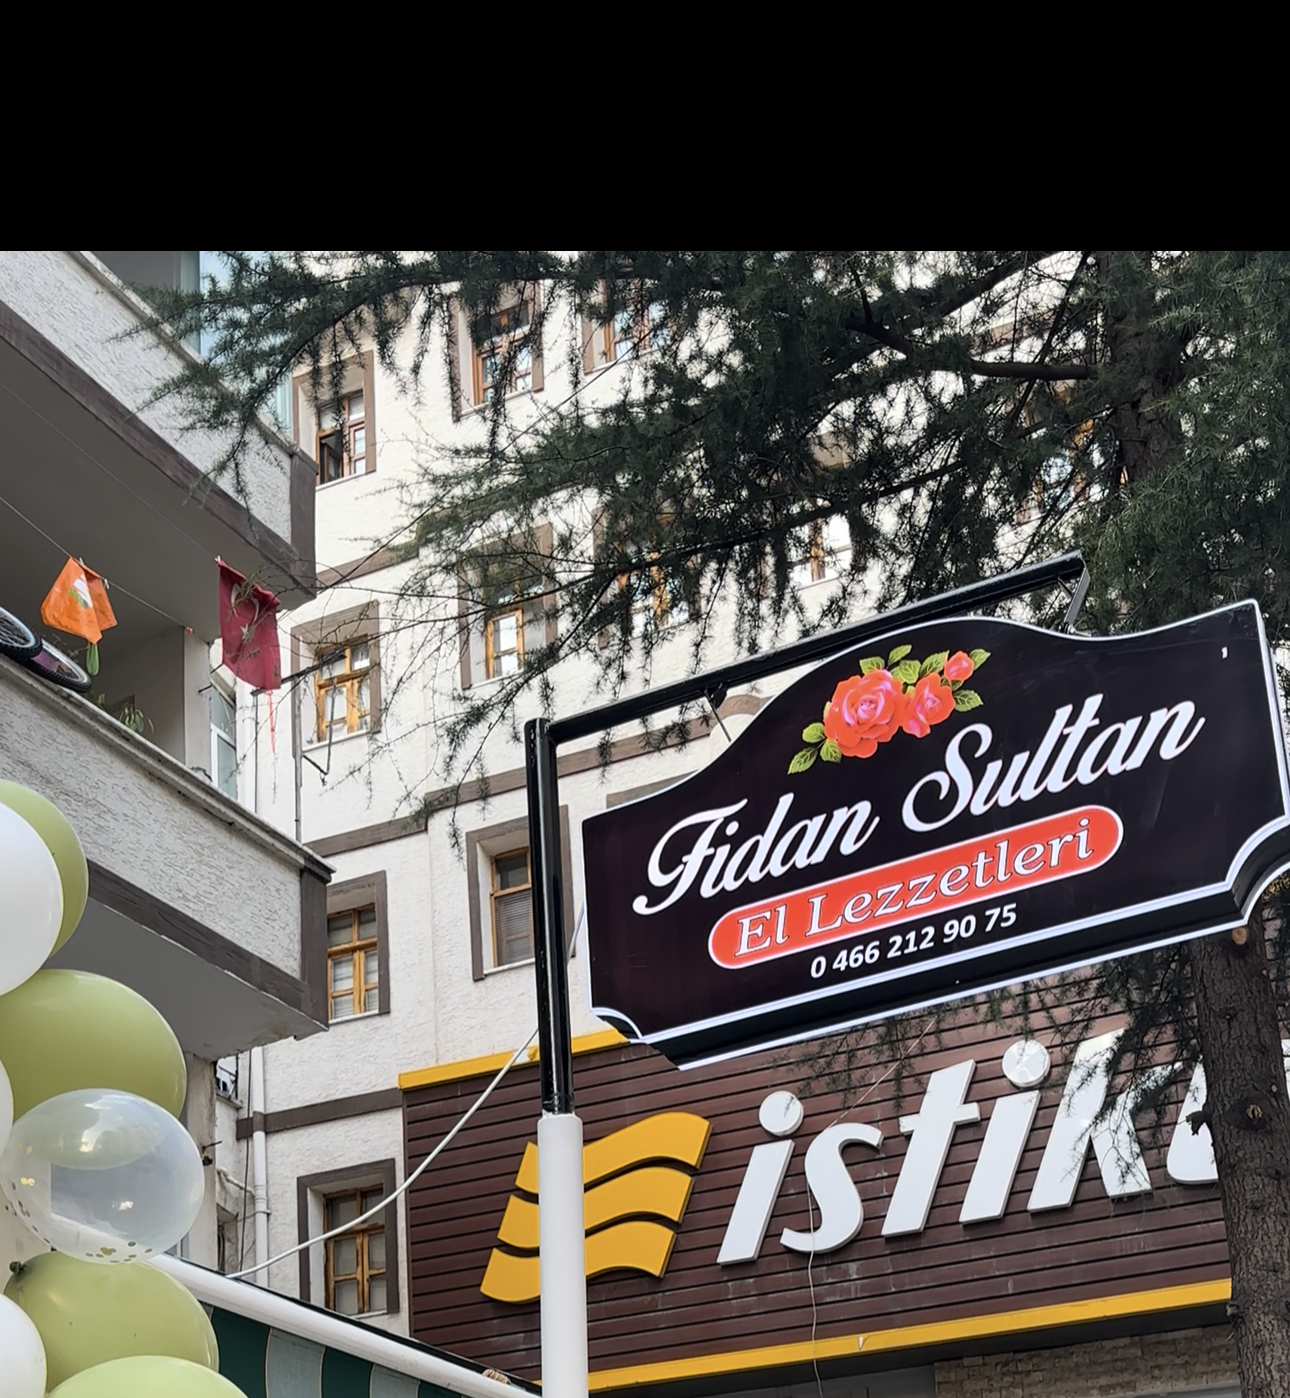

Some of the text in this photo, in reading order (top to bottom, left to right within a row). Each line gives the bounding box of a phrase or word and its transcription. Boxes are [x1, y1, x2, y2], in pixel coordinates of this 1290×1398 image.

[632, 693, 1206, 915] Fidan Sultan
[734, 817, 1094, 957] El Lezzetleri
[810, 903, 1017, 979] 0 466 212 90 75
